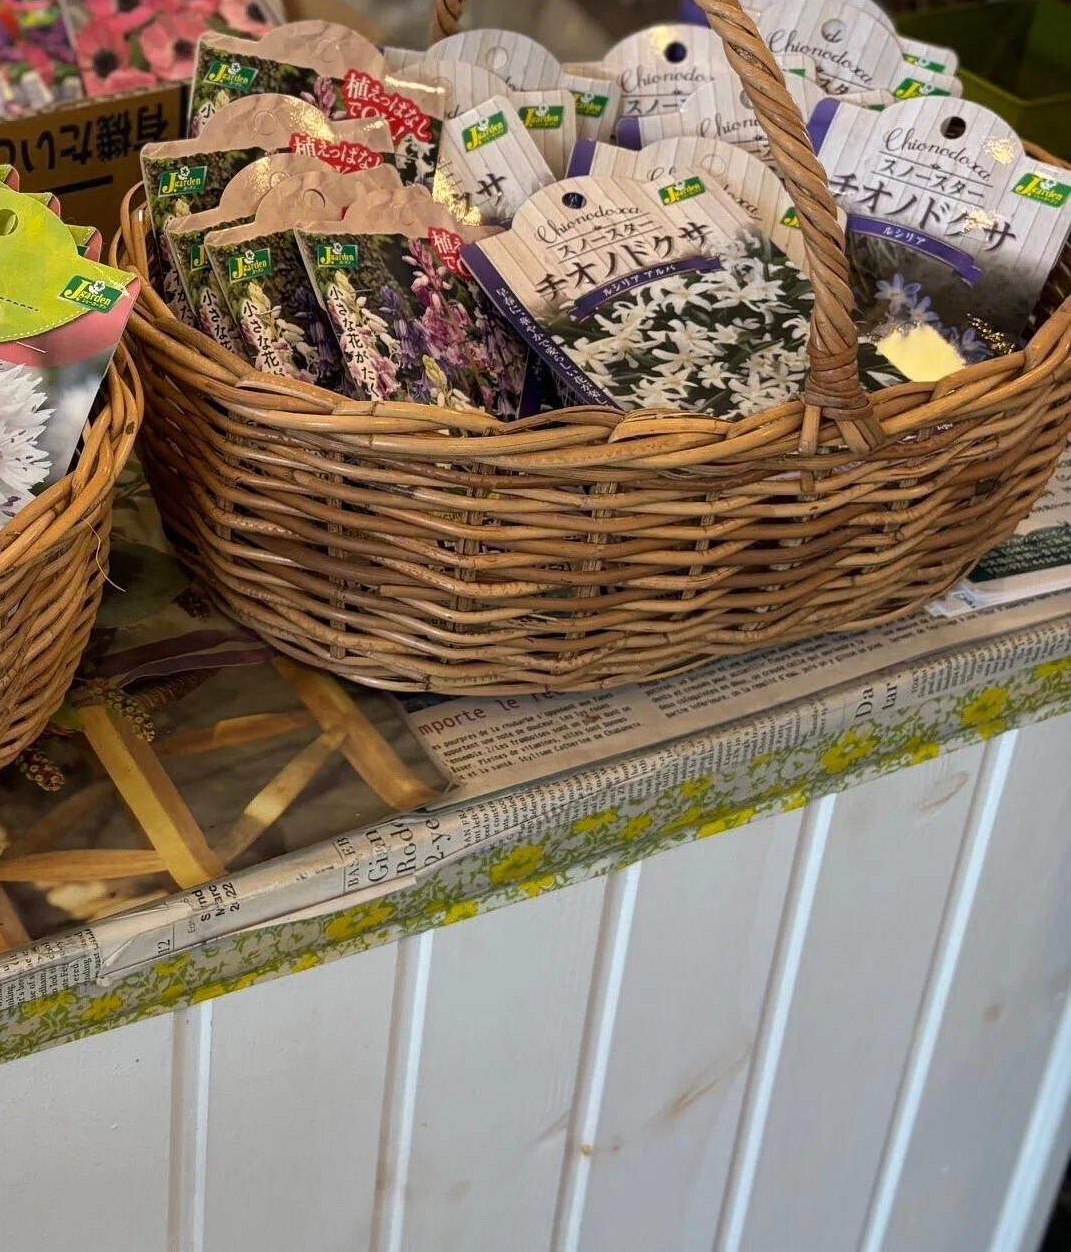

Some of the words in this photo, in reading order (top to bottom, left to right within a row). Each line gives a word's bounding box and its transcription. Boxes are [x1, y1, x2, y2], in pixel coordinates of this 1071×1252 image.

[766, 29, 874, 86] Chionodoxa
[878, 157, 985, 199] スノースター
[882, 127, 991, 183] Chionodoxa
[534, 205, 642, 245] Chionodoxa
[557, 218, 656, 261] スノースター
[882, 226, 927, 246] ルシリア
[534, 221, 711, 301] チオノドクサ
[243, 300, 286, 378] 小さな花
